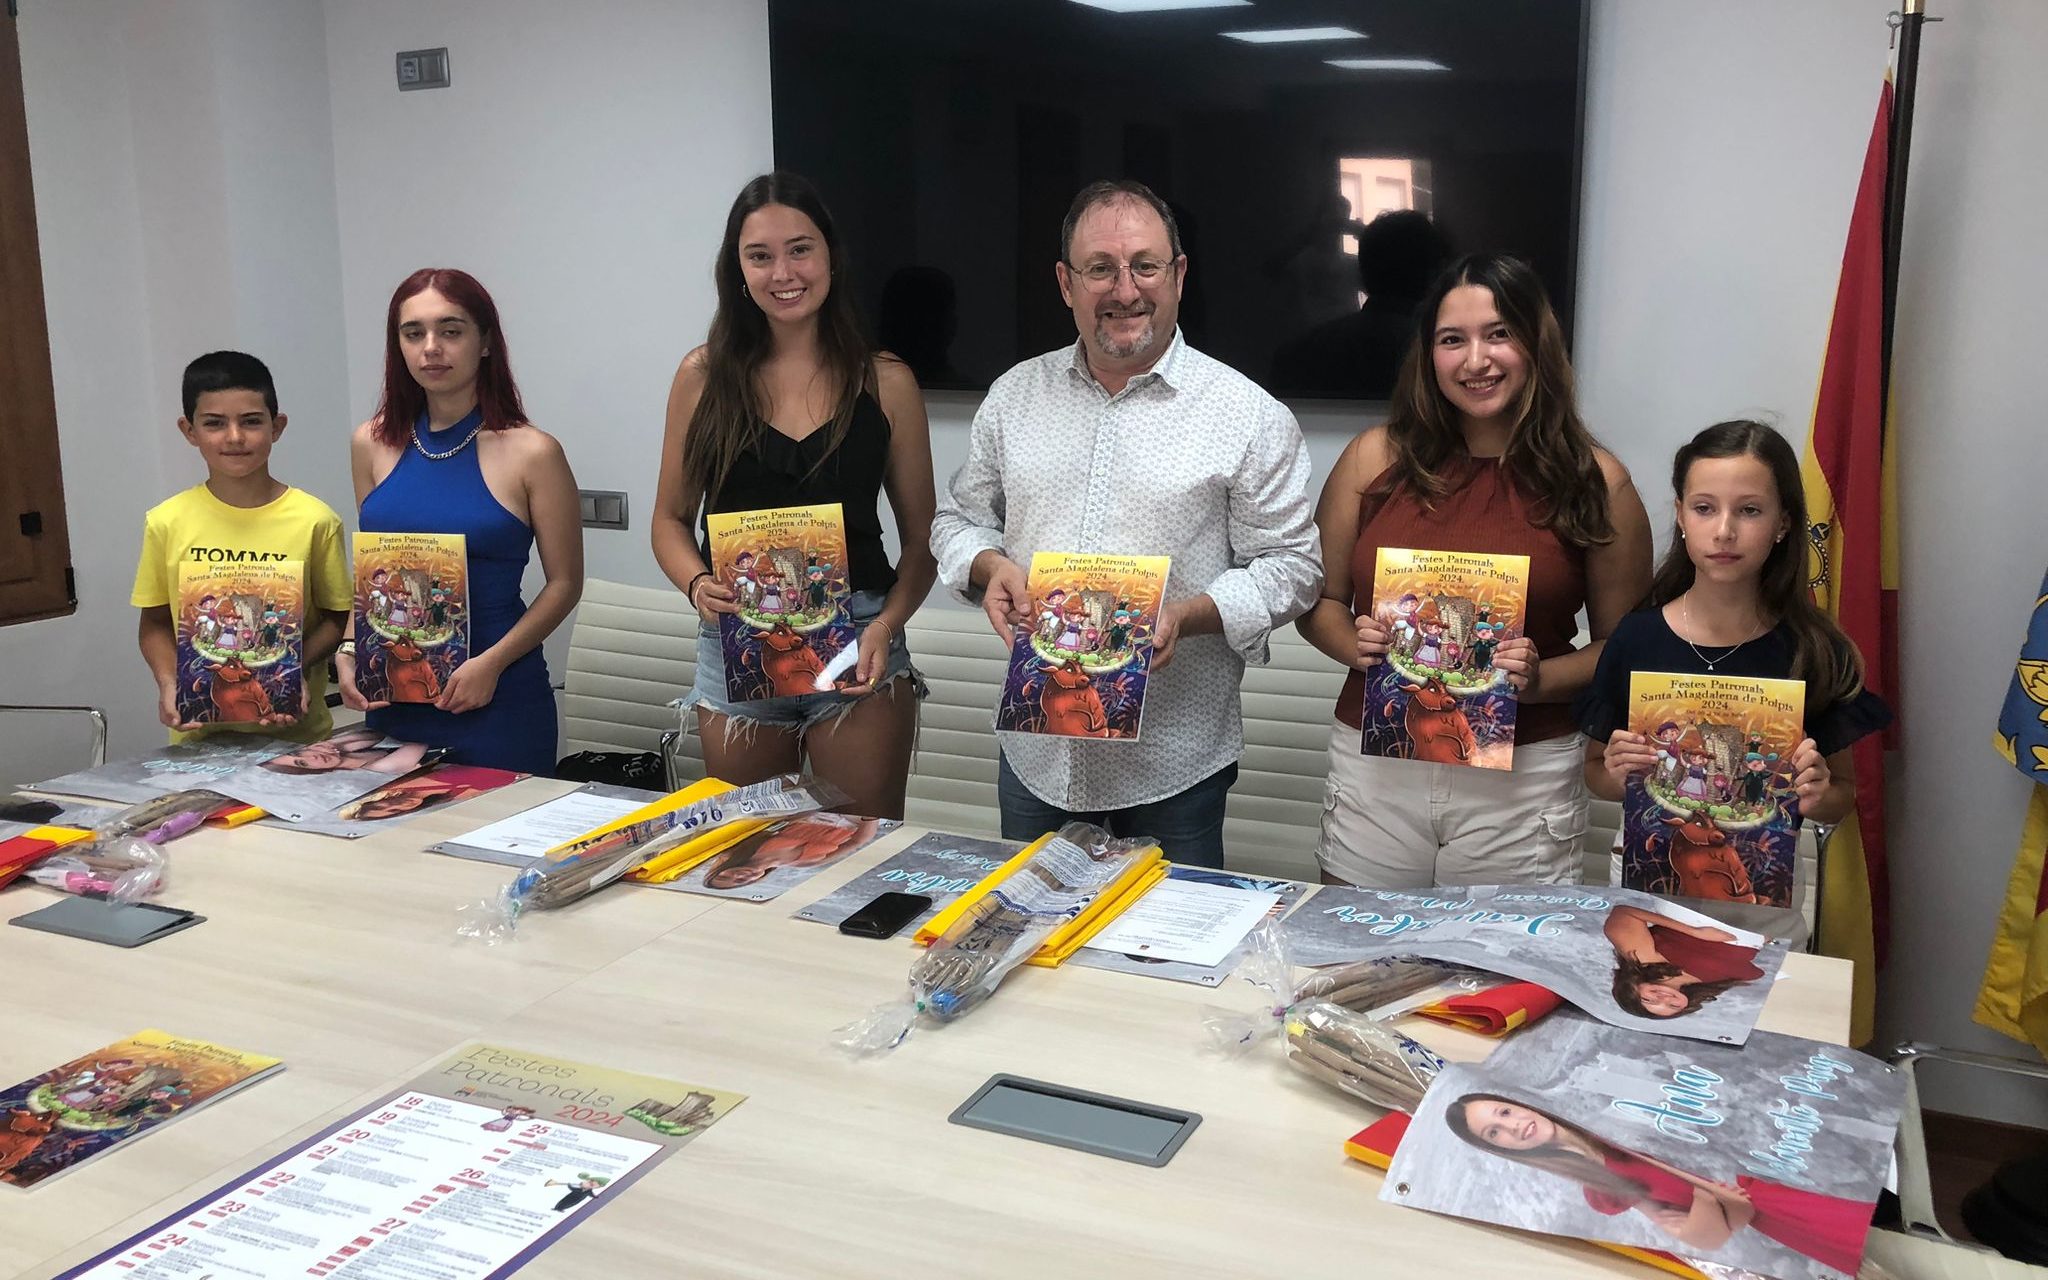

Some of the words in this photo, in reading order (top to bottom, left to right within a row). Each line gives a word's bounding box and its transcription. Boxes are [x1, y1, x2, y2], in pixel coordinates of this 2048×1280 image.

[740, 515, 768, 524] Festes
[771, 510, 813, 520] Patronals
[718, 529, 743, 539] Santa
[745, 520, 795, 531] Magdalena
[797, 519, 809, 527] de
[767, 528, 788, 537] 2024
[190, 547, 288, 562] TOMMY
[1095, 557, 1137, 567] Patronals
[1412, 555, 1444, 564] Festes
[1447, 555, 1494, 568] Patronals
[1038, 567, 1064, 575] Santa
[1066, 564, 1117, 573] Magdalena
[1119, 566, 1130, 574] de
[1384, 566, 1413, 576] Santa
[1416, 564, 1472, 574] Magdalena
[1474, 568, 1487, 576] de
[1086, 572, 1107, 580] 2024
[1438, 573, 1463, 583] 2024
[1670, 679, 1707, 689] Festes
[1710, 679, 1764, 694] Patronals
[1640, 692, 1672, 702] Santa
[1675, 689, 1739, 701] Magdalena
[1742, 692, 1757, 704] de
[1701, 700, 1729, 710] 2024
[466, 1047, 577, 1079] Festes
[441, 1061, 615, 1108] Patronals
[403, 1096, 424, 1106] 18
[376, 1111, 398, 1121] 19
[555, 1104, 625, 1128] 2024
[344, 1128, 370, 1140] 20
[525, 1124, 550, 1135] 25
[315, 1145, 338, 1156] 21
[269, 1171, 296, 1184] 22
[457, 1168, 485, 1179] 26
[218, 1200, 246, 1213] 23
[378, 1217, 408, 1230] 27
